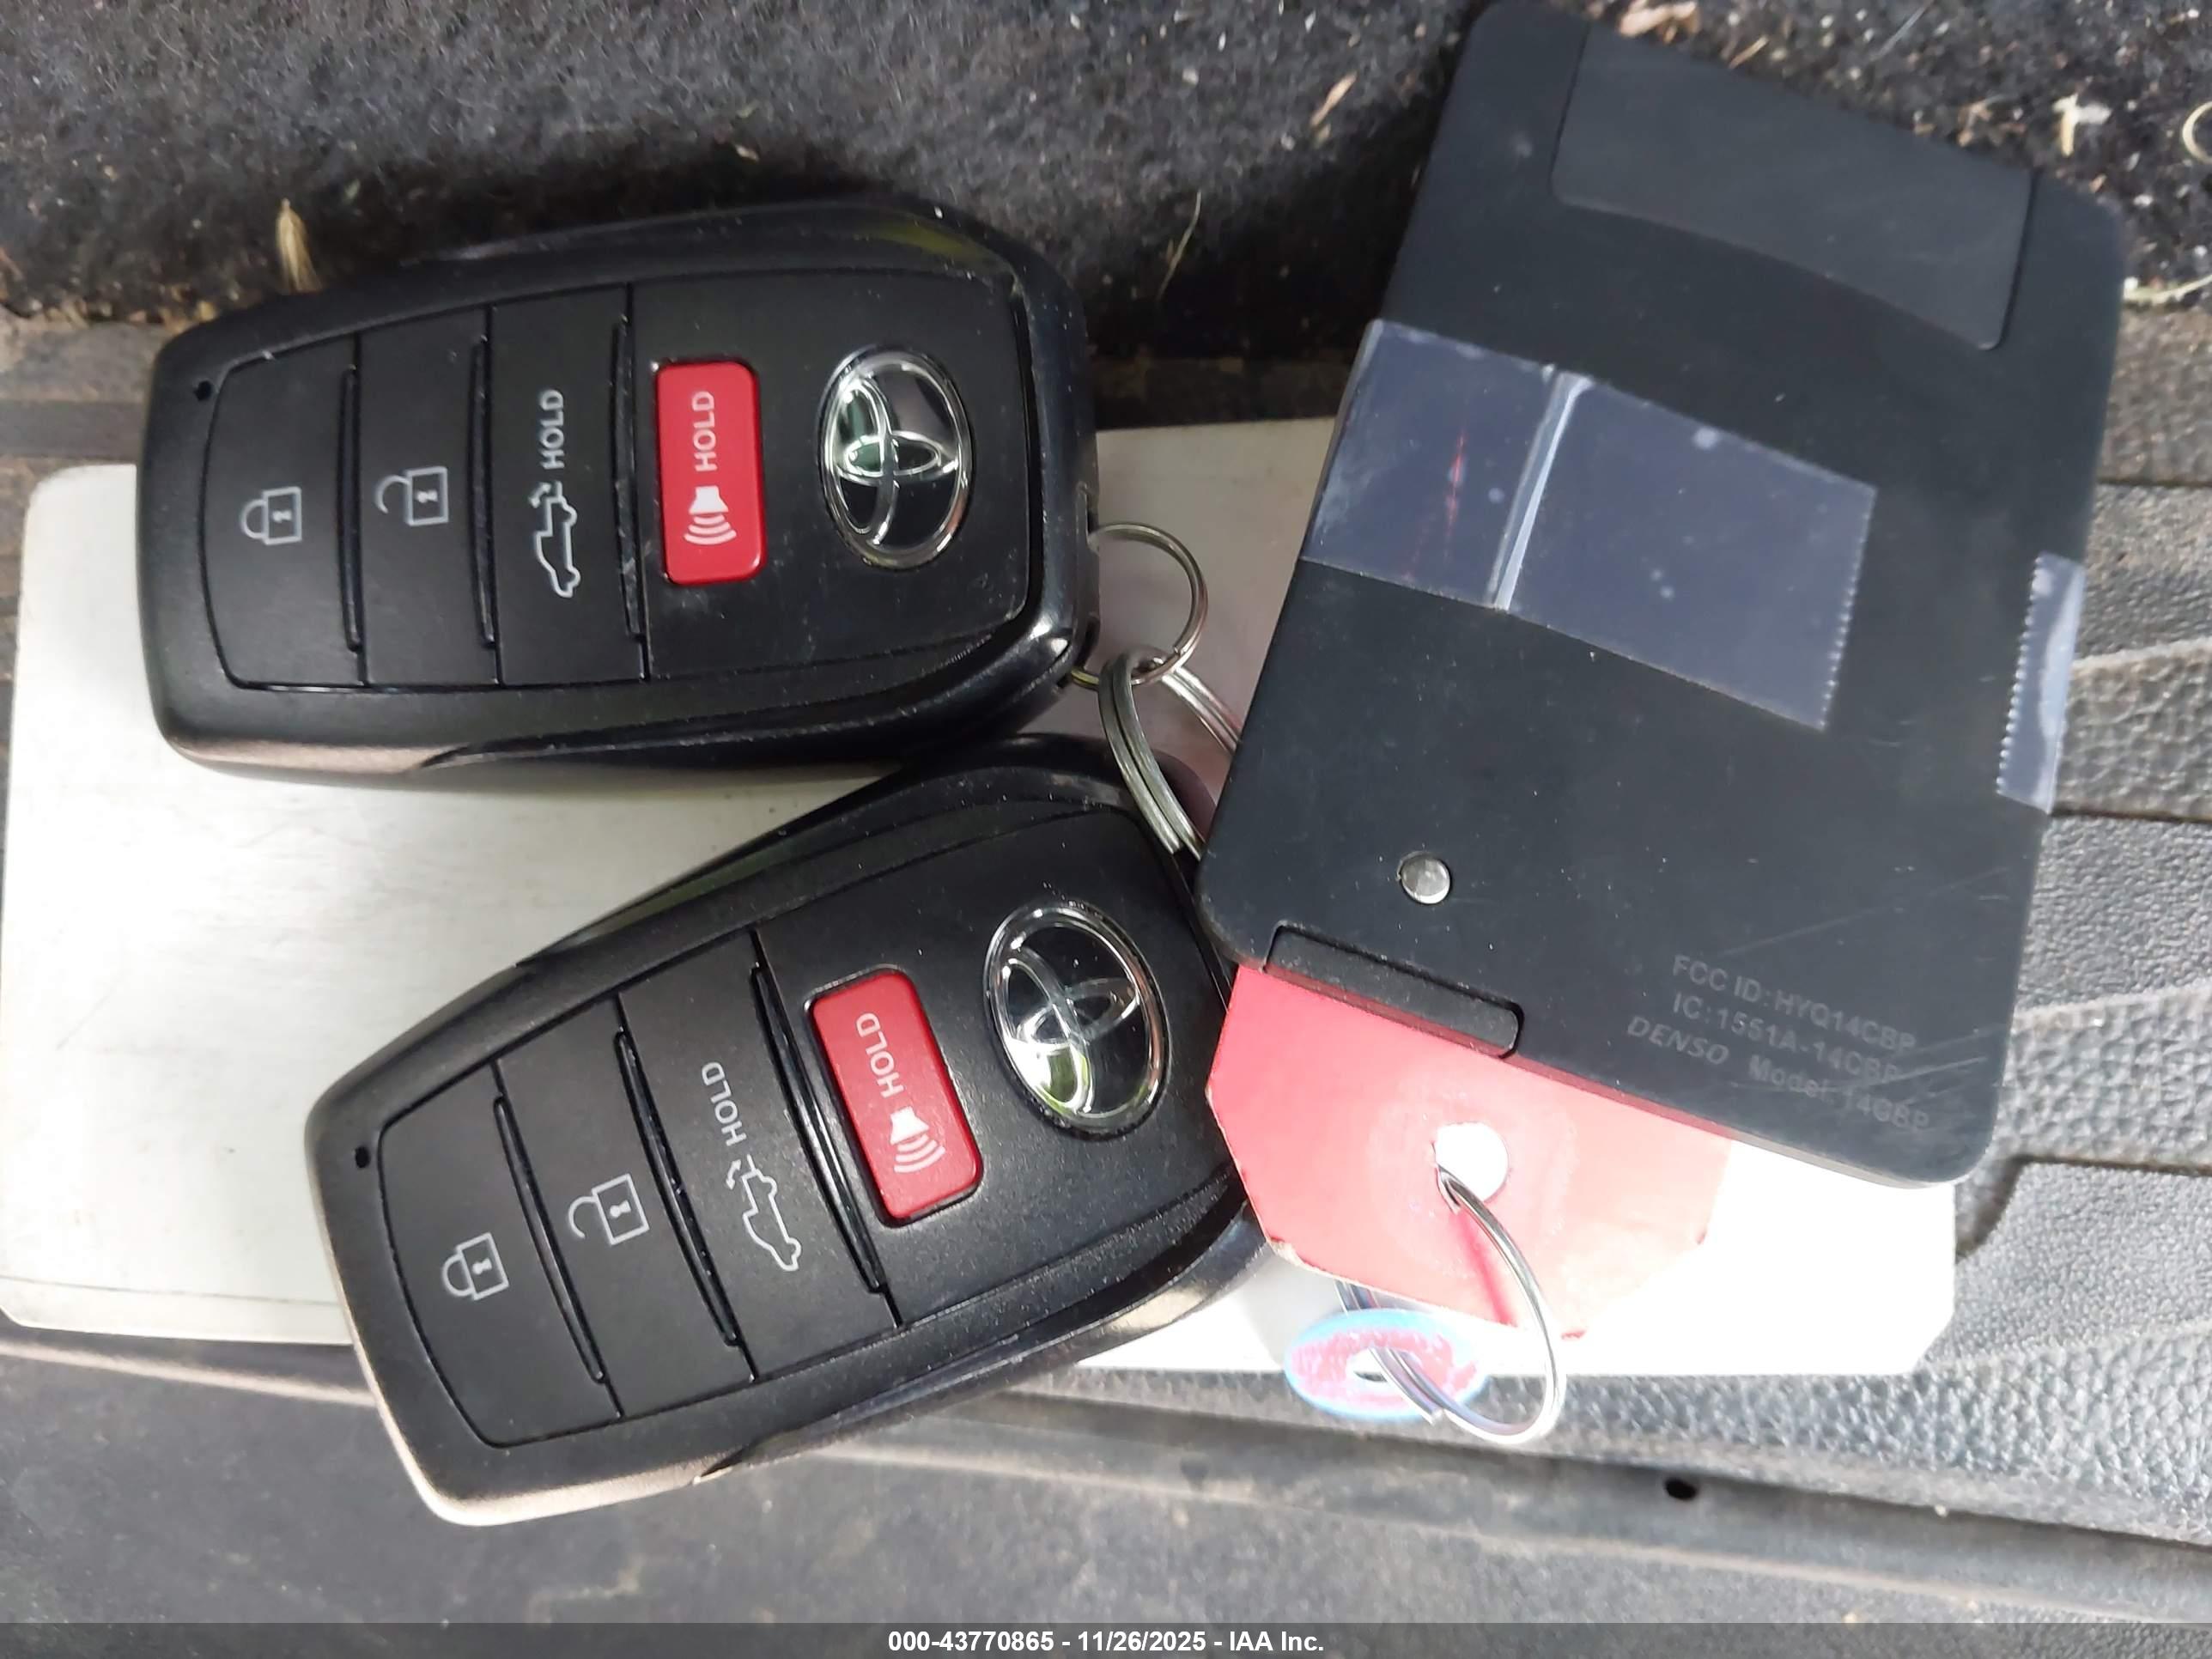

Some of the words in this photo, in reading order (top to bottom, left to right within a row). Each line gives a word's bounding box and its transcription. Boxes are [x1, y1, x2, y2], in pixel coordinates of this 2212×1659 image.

[541, 389, 565, 470] HOLD
[691, 391, 717, 471] HOLD
[1673, 954, 1727, 992] FCC
[856, 1013, 904, 1097] HOLD
[1627, 1016, 1729, 1065] DENSO
[702, 1062, 747, 1146] HOLD
